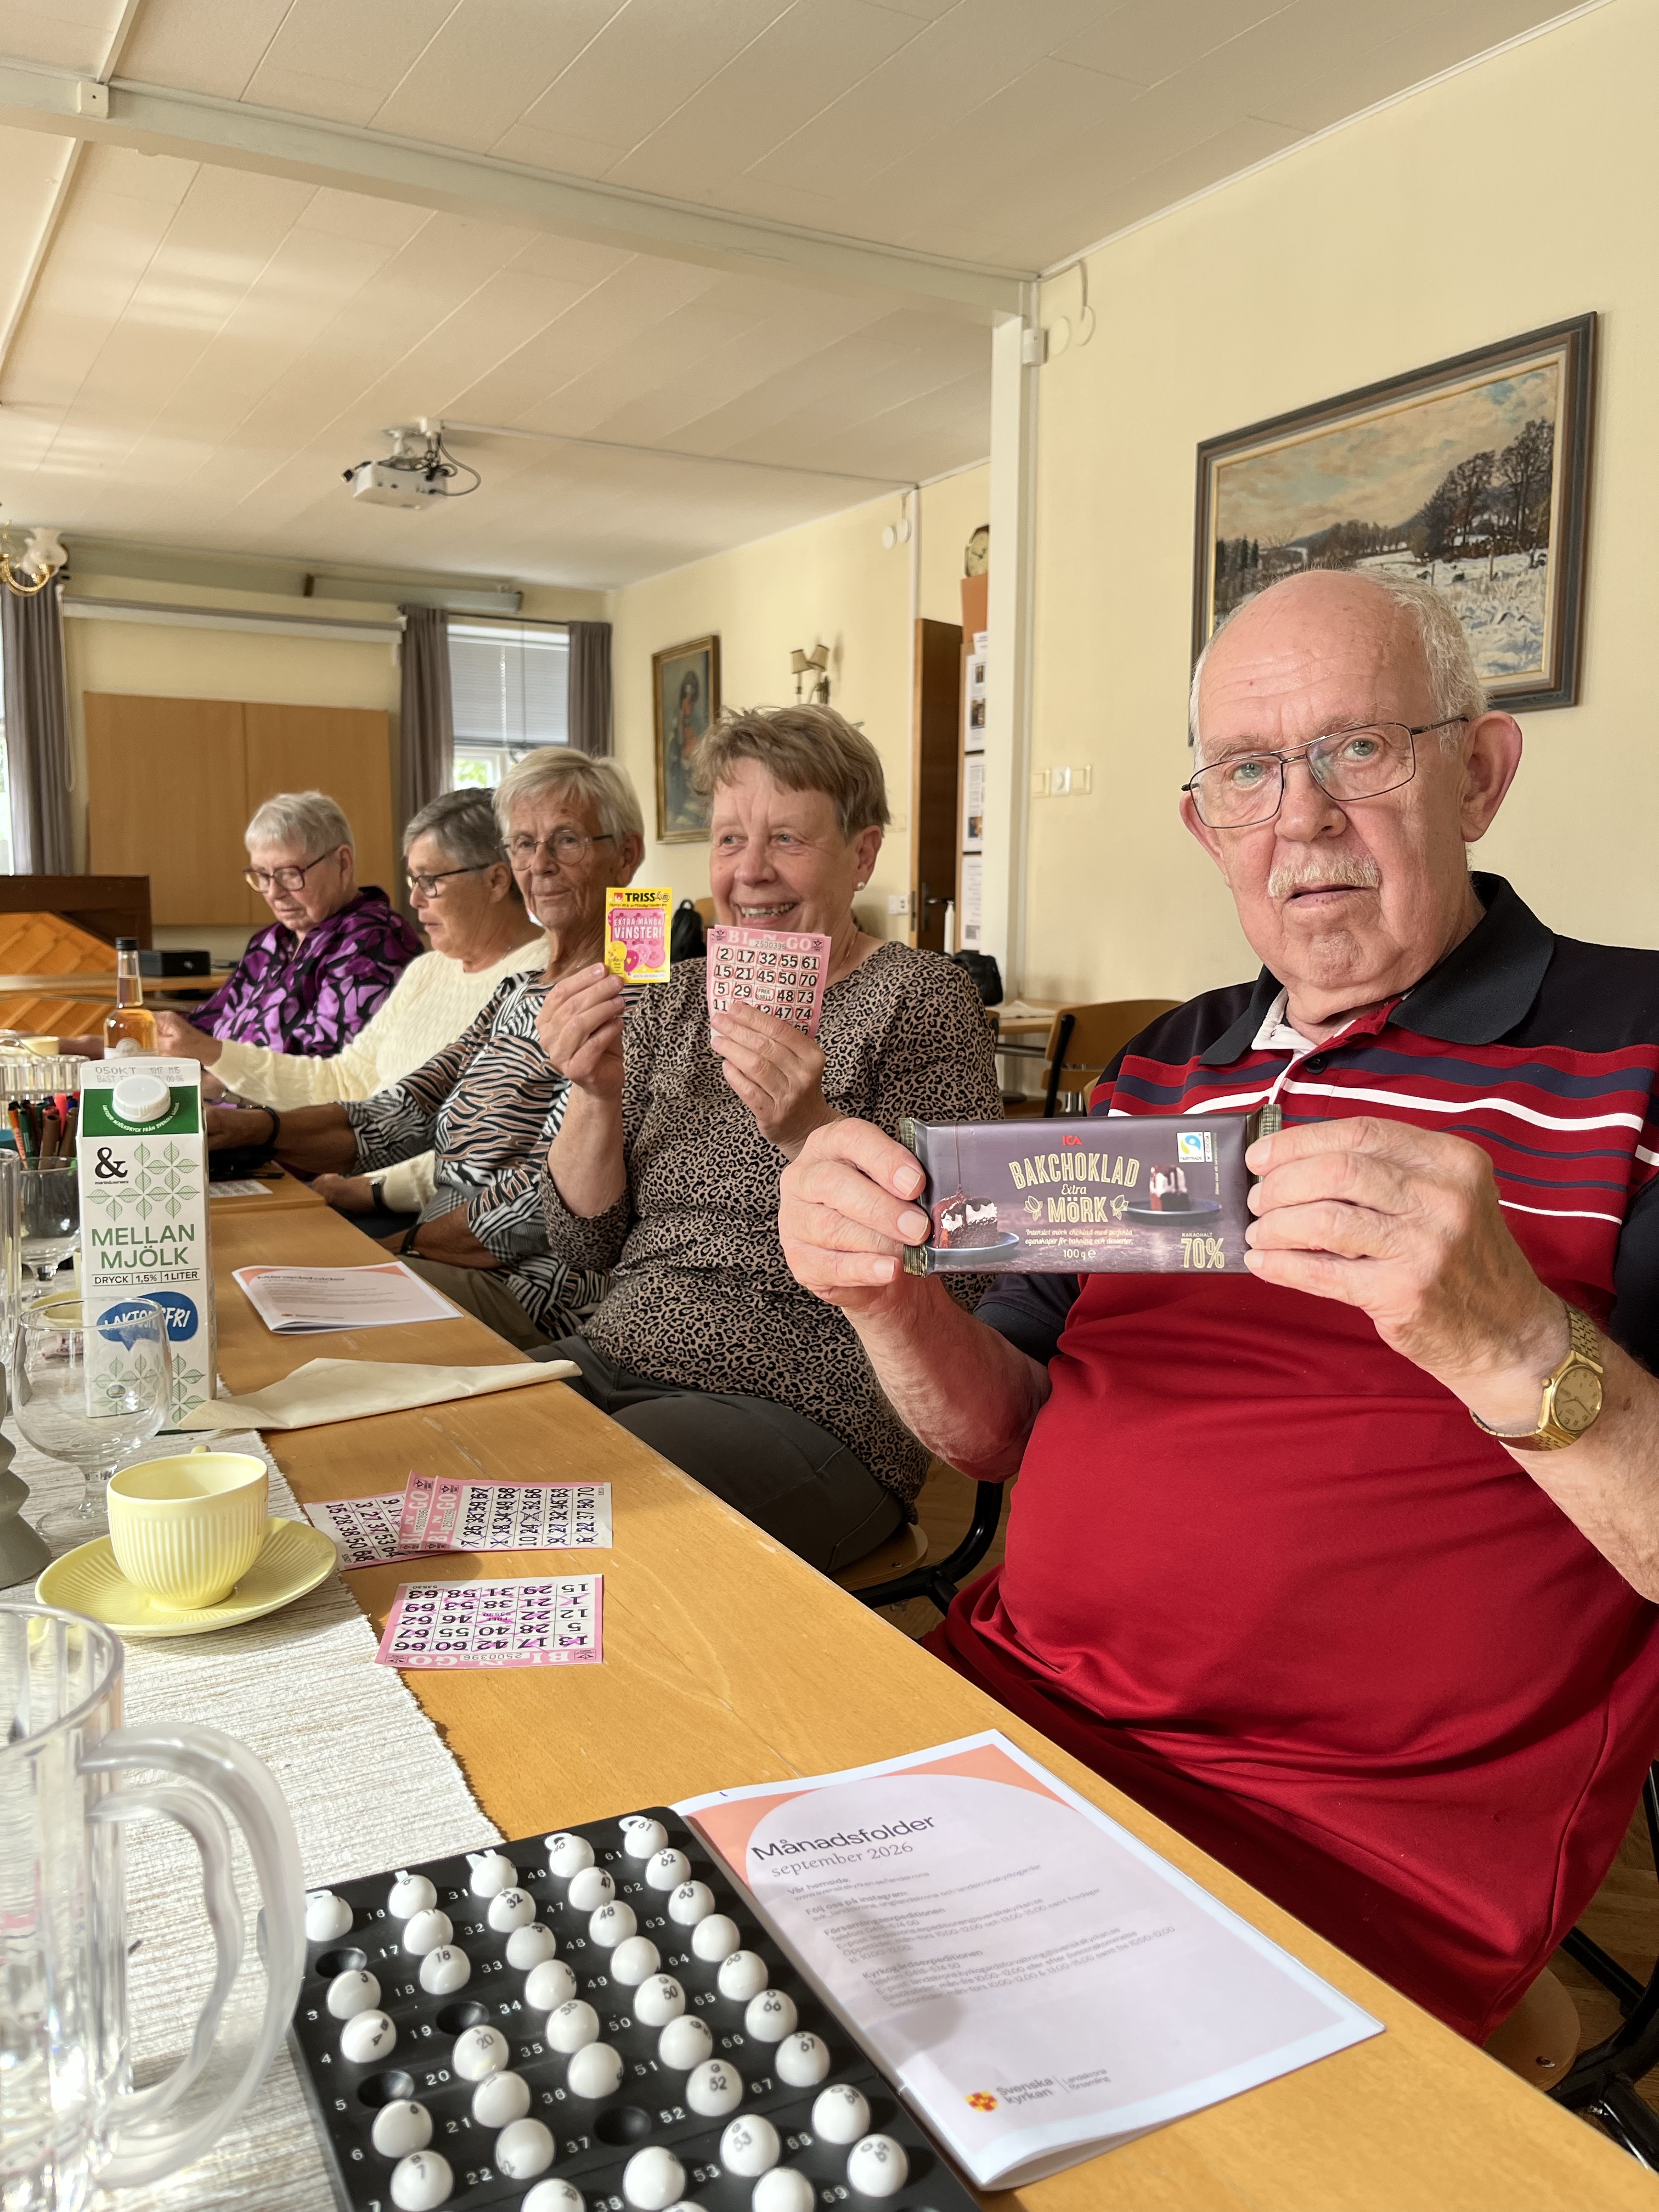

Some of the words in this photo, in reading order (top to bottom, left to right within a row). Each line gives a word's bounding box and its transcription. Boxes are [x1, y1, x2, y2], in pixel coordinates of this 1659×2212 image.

[625, 893, 655, 902] TRISS
[614, 918, 635, 926] EXTRA
[637, 916, 662, 926] MÅNGA
[755, 940, 786, 950] 2500396
[720, 948, 729, 960] 2
[738, 950, 754, 962] 17
[760, 952, 777, 965] 32
[781, 955, 798, 967] 55
[802, 957, 817, 969] 61
[715, 965, 731, 977] 15
[736, 968, 752, 980] 21
[757, 970, 774, 983] 45
[779, 973, 795, 985] 50
[800, 974, 817, 986] 70
[718, 983, 725, 994] 5
[734, 985, 751, 997] 29
[777, 990, 794, 1002] 48
[798, 991, 814, 1003] 73
[713, 999, 727, 1012] 11
[775, 1007, 791, 1019] 47
[796, 1008, 811, 1020] 74
[1062, 1135, 1082, 1146] ICA
[94, 1147, 128, 1179] &
[1008, 1152, 1140, 1190] BAKCHOKLAD
[1061, 1183, 1087, 1195] Extra
[1047, 1196, 1109, 1223] MÖRK
[92, 1224, 195, 1246] MELLAN
[1109, 1228, 1133, 1237] perfekta
[1025, 1237, 1058, 1246] egenskaper
[1058, 1237, 1068, 1246] för
[101, 1245, 189, 1269] MJÖLK
[1063, 1249, 1080, 1259] 100
[1080, 1251, 1086, 1261] g
[1181, 1238, 1225, 1269] 70%
[95, 1275, 129, 1285] DRYCK
[135, 1273, 157, 1284] 1,5%
[171, 1271, 198, 1280] LITER
[524, 1488, 542, 1499] 66
[577, 1487, 595, 1497] 70
[577, 1499, 595, 1509] 50
[332, 1514, 354, 1526] 28
[360, 1511, 382, 1521] 27
[576, 1511, 594, 1520] 37
[339, 1526, 360, 1537] 38
[368, 1523, 390, 1533] 37
[463, 1525, 483, 1537] 26
[346, 1537, 368, 1550] 50
[375, 1534, 397, 1545] 53
[519, 1536, 538, 1546] 10
[353, 1550, 375, 1562] 68
[448, 1589, 476, 1598] 58
[523, 1585, 552, 1595] 29
[561, 1583, 589, 1593] 15
[408, 1590, 438, 1599] 63
[405, 1603, 436, 1612] 69
[444, 1601, 474, 1611] 53
[483, 1600, 514, 1609] 38
[442, 1615, 472, 1624] 46
[521, 1611, 551, 1621] 22
[560, 1609, 588, 1618] 12
[439, 1628, 470, 1638] 55
[478, 1626, 511, 1636] 40
[520, 1624, 550, 1634] 28
[567, 1622, 582, 1632] 5
[397, 1629, 430, 1639] 67
[394, 1641, 426, 1651] 66
[435, 1641, 467, 1651] 60
[517, 1638, 548, 1649] 17
[751, 1816, 935, 1861] Månadsfolder
[661, 1853, 676, 1866] 62
[771, 1850, 864, 1877] september
[867, 1841, 913, 1860] 2026
[527, 1869, 546, 1880] 46
[623, 1882, 644, 1894] 62
[788, 1884, 805, 1895] Vår
[806, 1877, 851, 1890] hemsida:
[449, 1887, 469, 1900] 31
[679, 1887, 694, 1899] 63
[506, 1893, 523, 1909] 32
[805, 1903, 826, 1916] Följ
[826, 1901, 843, 1910] oss
[845, 1897, 859, 1906] på
[366, 1909, 385, 1920] 16
[646, 1916, 665, 1928] 63
[824, 1908, 946, 1936] Församlingsexpeditionen
[464, 1922, 485, 1935] 32
[566, 1938, 586, 1950] 48
[669, 1953, 689, 1966] 64
[862, 1950, 984, 1980] Kyrkogårdsexpeditionen
[394, 1984, 415, 1997] 18
[694, 1992, 715, 2006] 65
[499, 2000, 522, 2015] 34
[307, 2010, 318, 2021] 3
[608, 2017, 631, 2031] 50
[521, 2042, 543, 2058] 35
[321, 2053, 331, 2063] 4
[426, 2069, 450, 2086] 20
[709, 2075, 727, 2092] 52
[751, 2078, 772, 2094] 67
[996, 2077, 1054, 2096] Svenska
[1003, 2087, 1053, 2104] kyrkan
[335, 2098, 346, 2111] 5
[660, 2107, 686, 2123] 52
[446, 2117, 471, 2134] 21
[566, 2136, 588, 2153] 37
[351, 2149, 363, 2160] 6
[466, 2168, 493, 2185] 22
[693, 2164, 721, 2182] 53
[823, 2186, 848, 2204] 69
[596, 2197, 622, 2212] 38
